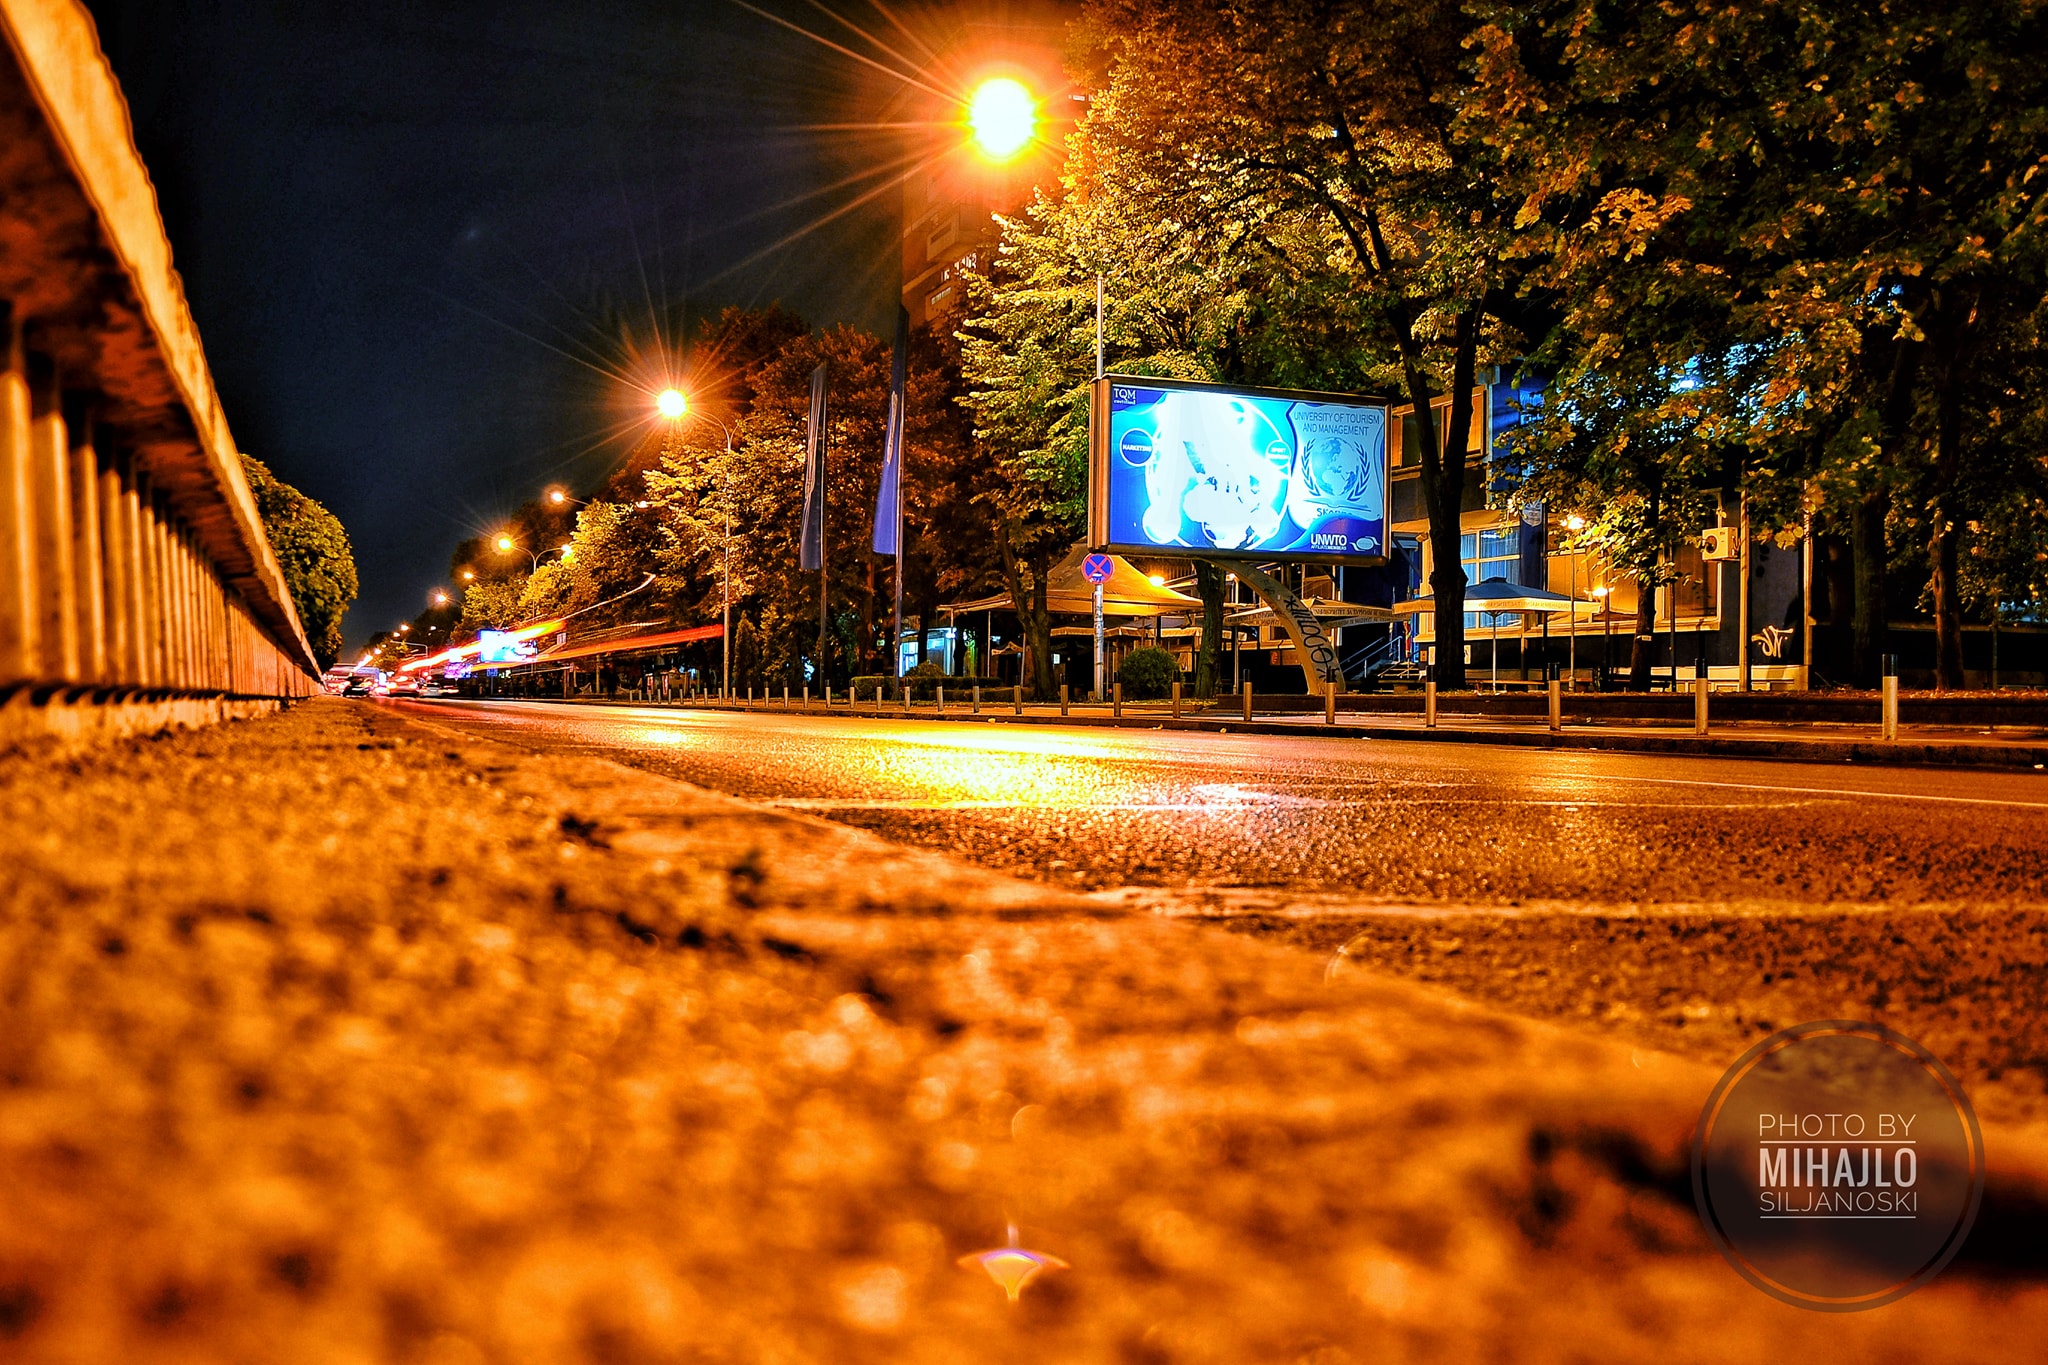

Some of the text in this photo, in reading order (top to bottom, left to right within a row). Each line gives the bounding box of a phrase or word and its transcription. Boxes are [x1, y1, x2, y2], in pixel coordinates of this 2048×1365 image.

[1113, 388, 1136, 400] TQM
[1294, 411, 1380, 425] UNIVERSITY OF TOURISM
[1303, 423, 1369, 436] AND MANAGEMENT
[1310, 533, 1347, 546] UNWTO
